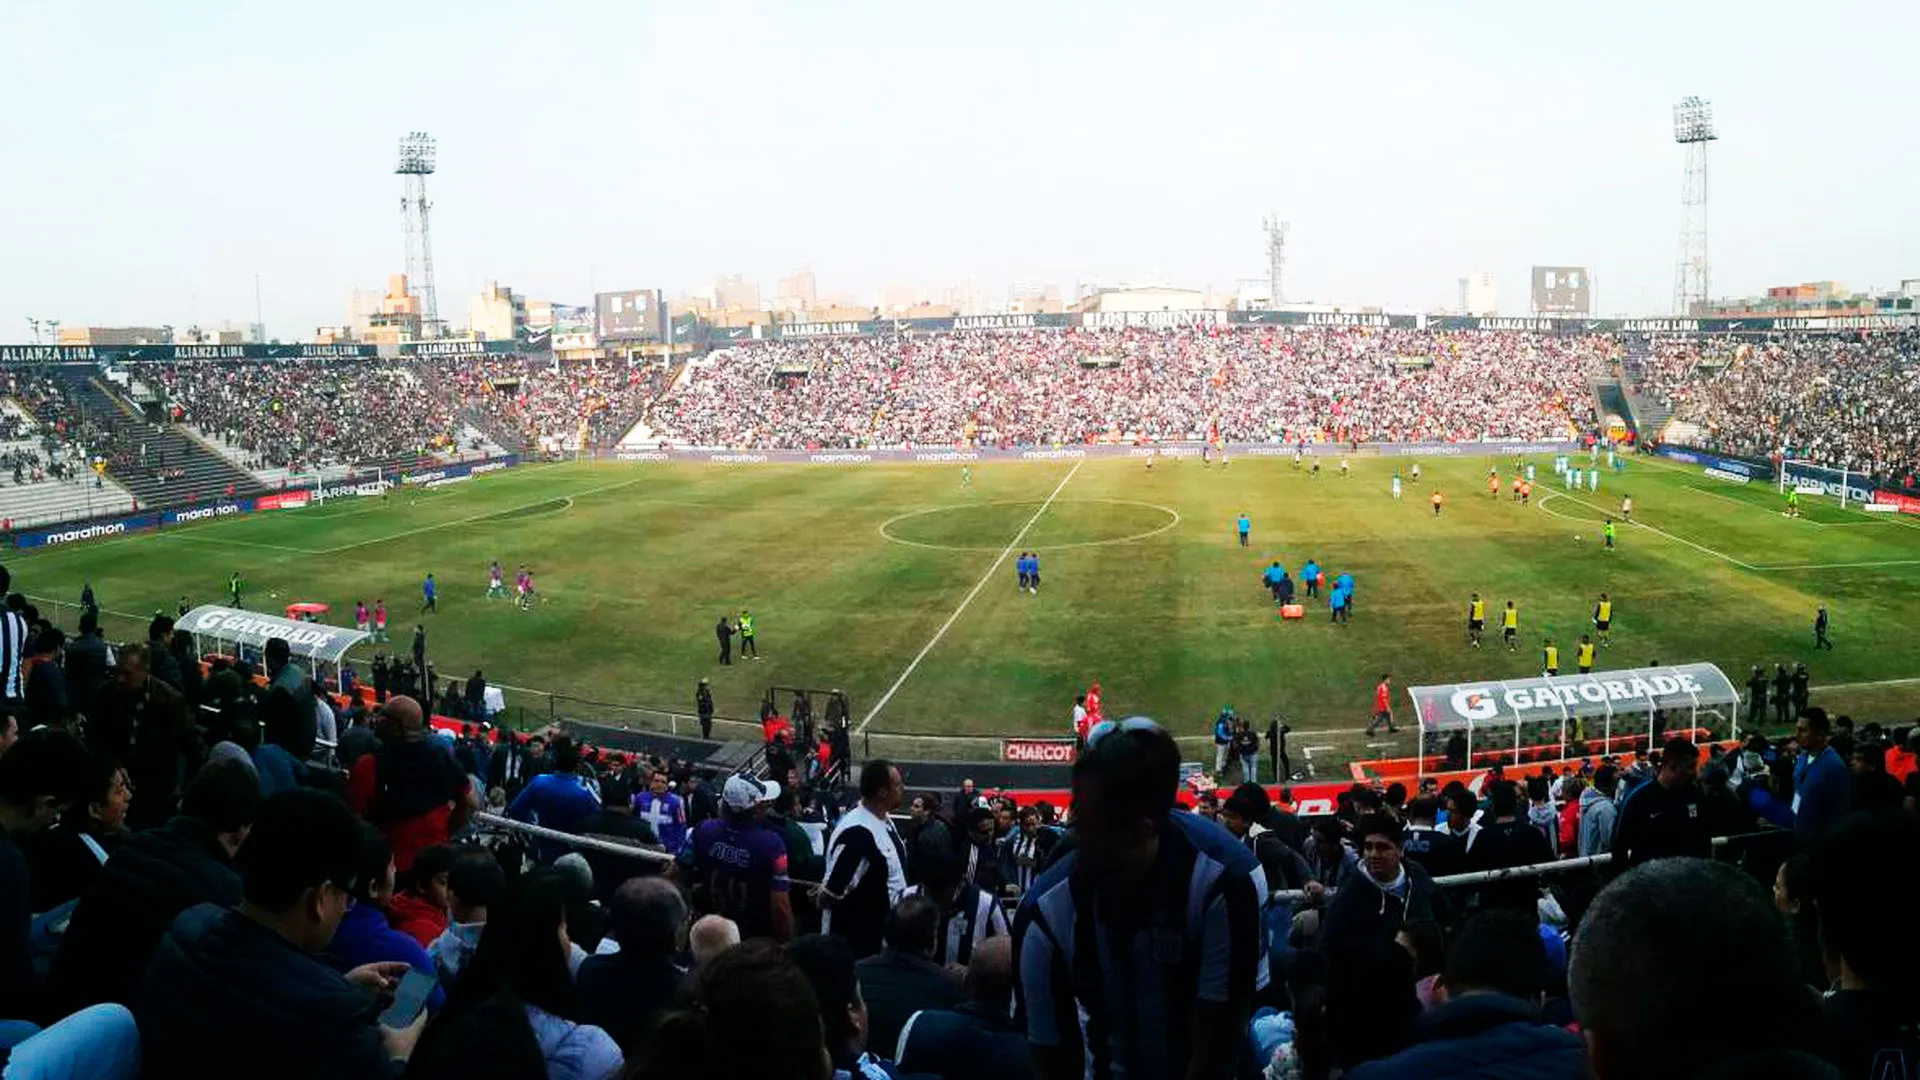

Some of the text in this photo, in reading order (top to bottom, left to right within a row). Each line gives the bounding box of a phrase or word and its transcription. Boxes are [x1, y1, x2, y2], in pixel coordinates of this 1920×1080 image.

[954, 315, 1034, 329] ALIANZA LIMA
[1308, 314, 1391, 326] ALIANZA LIMA
[1480, 319, 1524, 330] ALIANZA
[1624, 320, 1698, 331] ALIANZA LIMA
[782, 322, 859, 336] ALIANZA LIMA
[2, 347, 96, 361] ALIANZA LIMA
[175, 345, 245, 358] ALIANZA LIMA
[417, 344, 458, 353] ALIANZA
[917, 452, 978, 462] marathon
[1024, 449, 1085, 459] marathon
[47, 521, 125, 544] marathon
[221, 615, 336, 648] GATORADE
[1504, 674, 1702, 710] GATORADE
[1007, 744, 1073, 760] CHARCOT
